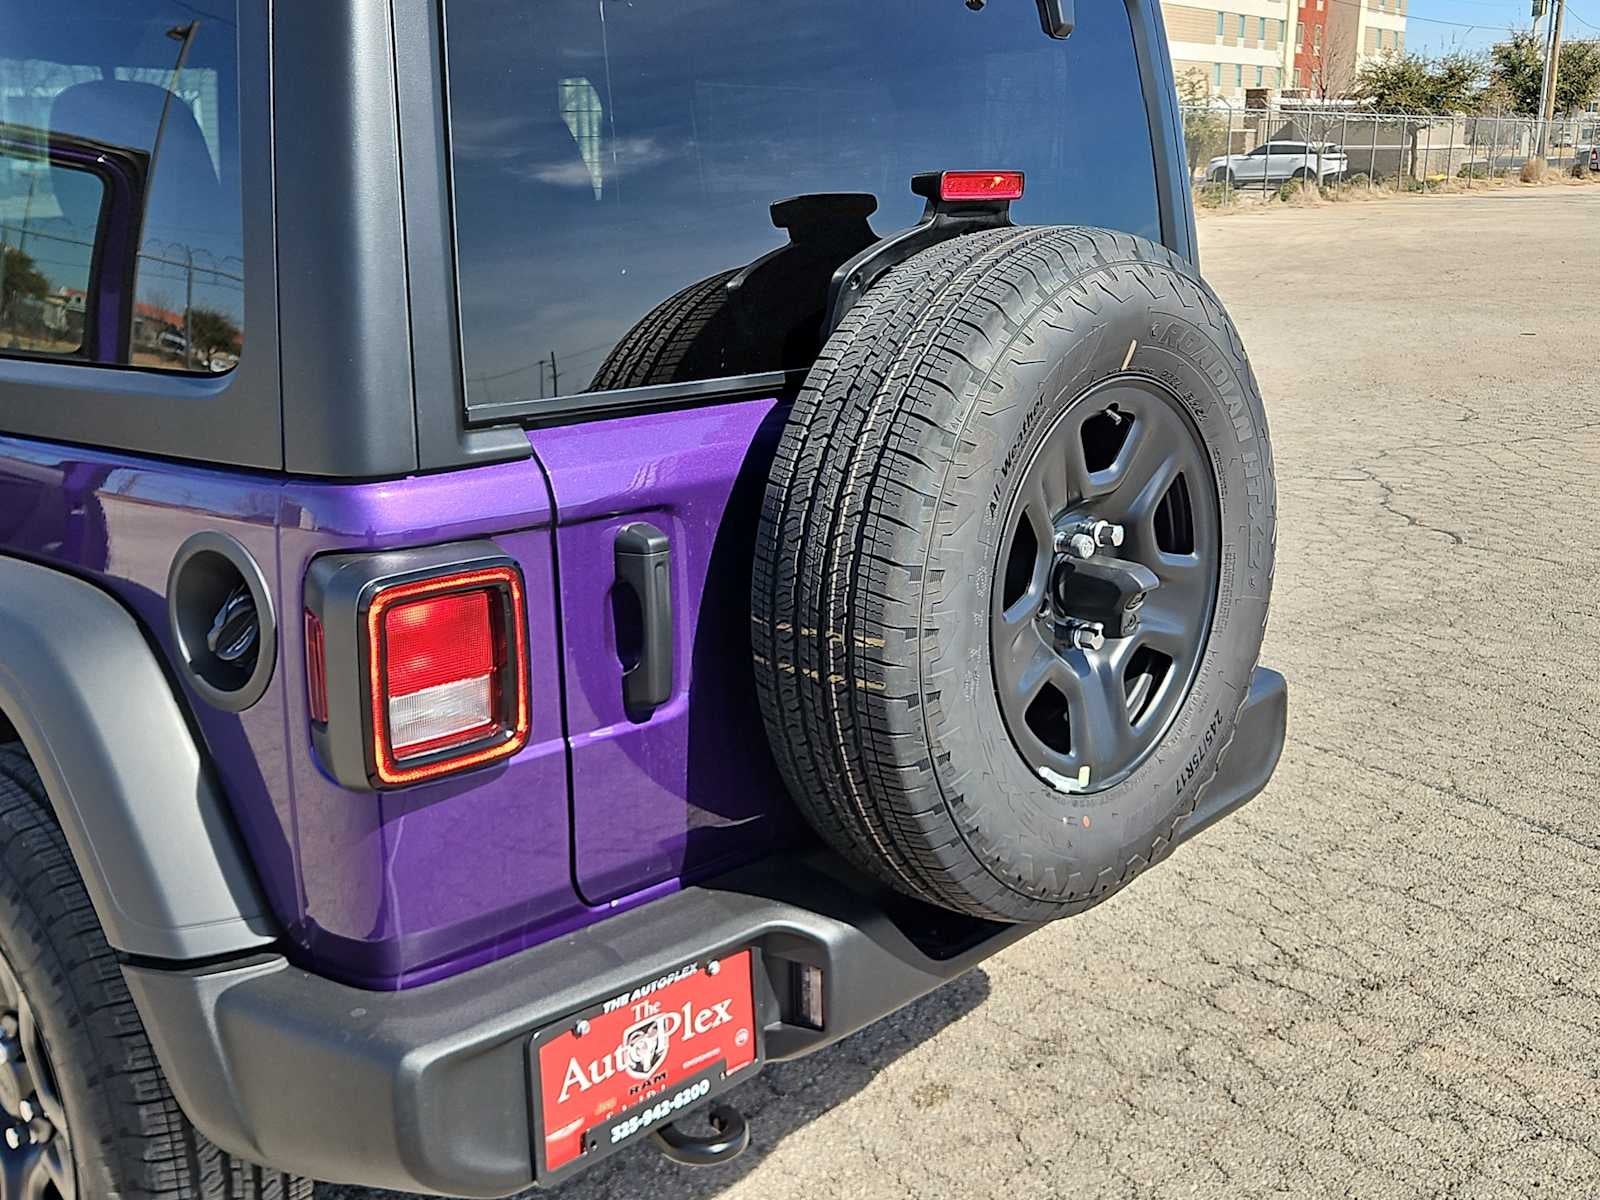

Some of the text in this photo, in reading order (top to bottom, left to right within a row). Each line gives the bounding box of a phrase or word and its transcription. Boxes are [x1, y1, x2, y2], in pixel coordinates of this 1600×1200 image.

[989, 392, 1045, 518] All Weather
[1175, 708, 1224, 796] 245/75R17
[603, 962, 699, 1014] THE AUTOPLEX
[631, 999, 661, 1022] The
[629, 1072, 667, 1096] RAM
